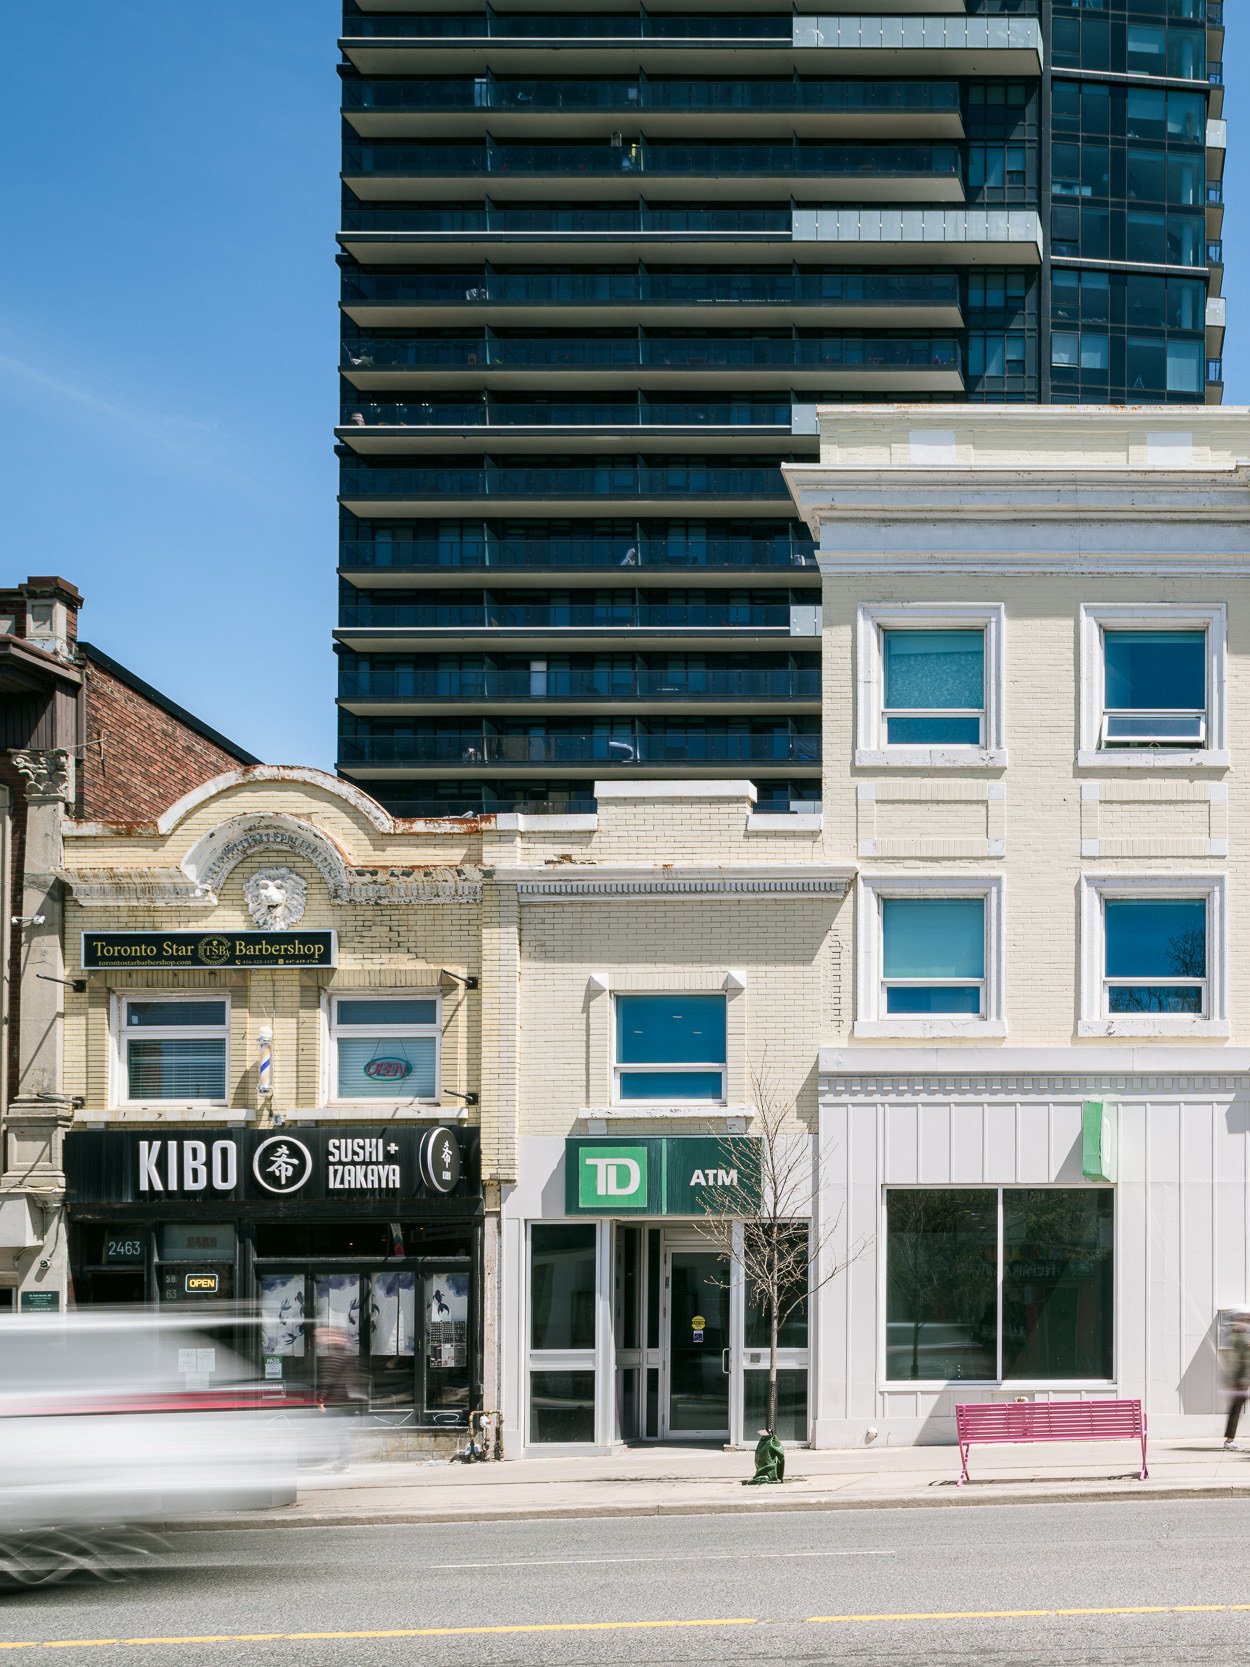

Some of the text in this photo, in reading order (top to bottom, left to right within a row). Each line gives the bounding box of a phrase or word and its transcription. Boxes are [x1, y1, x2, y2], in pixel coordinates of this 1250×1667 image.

[93, 941, 156, 957] Toronto
[162, 941, 194, 957] Star
[234, 940, 324, 958] Barbershop
[328, 1138, 383, 1162] SUSHI
[139, 1140, 237, 1191] KIBO
[328, 1165, 400, 1188] IZAKAYA
[585, 1158, 641, 1196] TD
[689, 1169, 738, 1186] ATM
[108, 1241, 141, 1255] 2463
[189, 1279, 215, 1288] OPEN
[165, 1289, 177, 1299] 63
